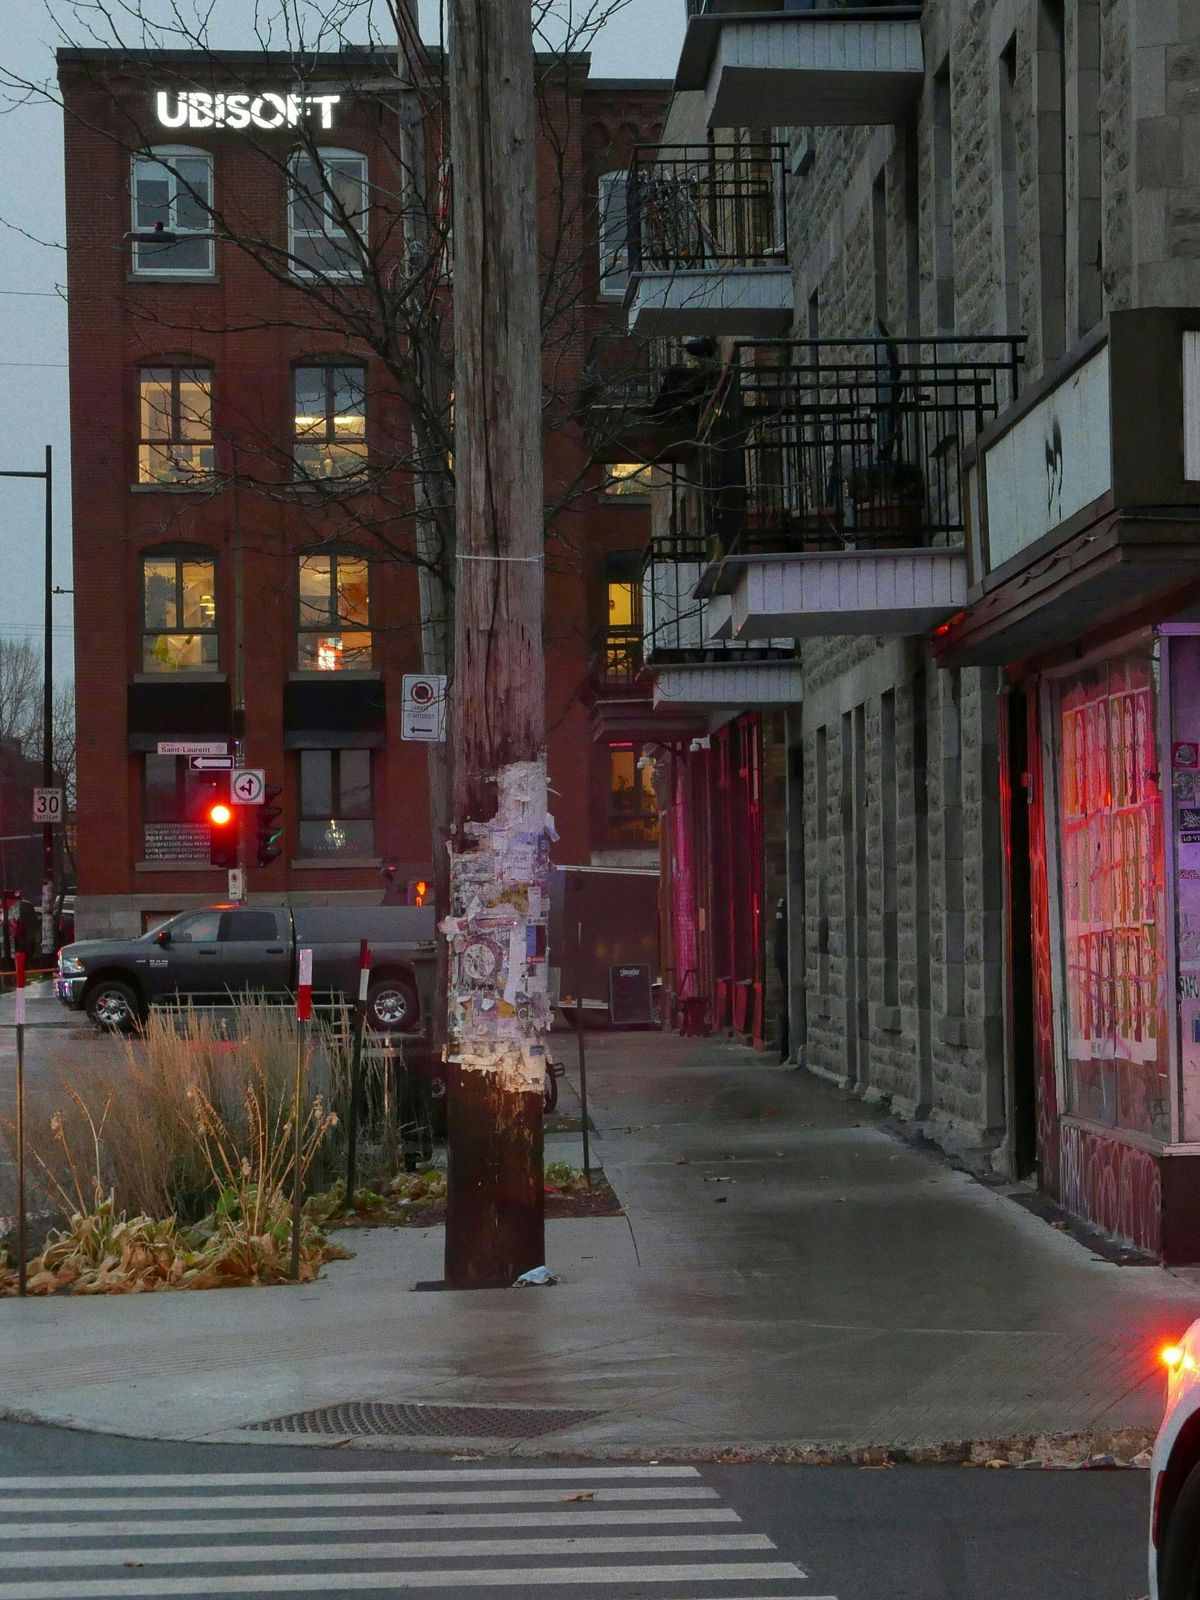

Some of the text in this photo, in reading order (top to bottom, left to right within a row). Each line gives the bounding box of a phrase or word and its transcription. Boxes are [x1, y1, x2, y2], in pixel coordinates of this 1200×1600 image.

[156, 91, 341, 129] UBISOFT
[160, 746, 211, 754] Saint-Laurent
[37, 796, 59, 813] 30
